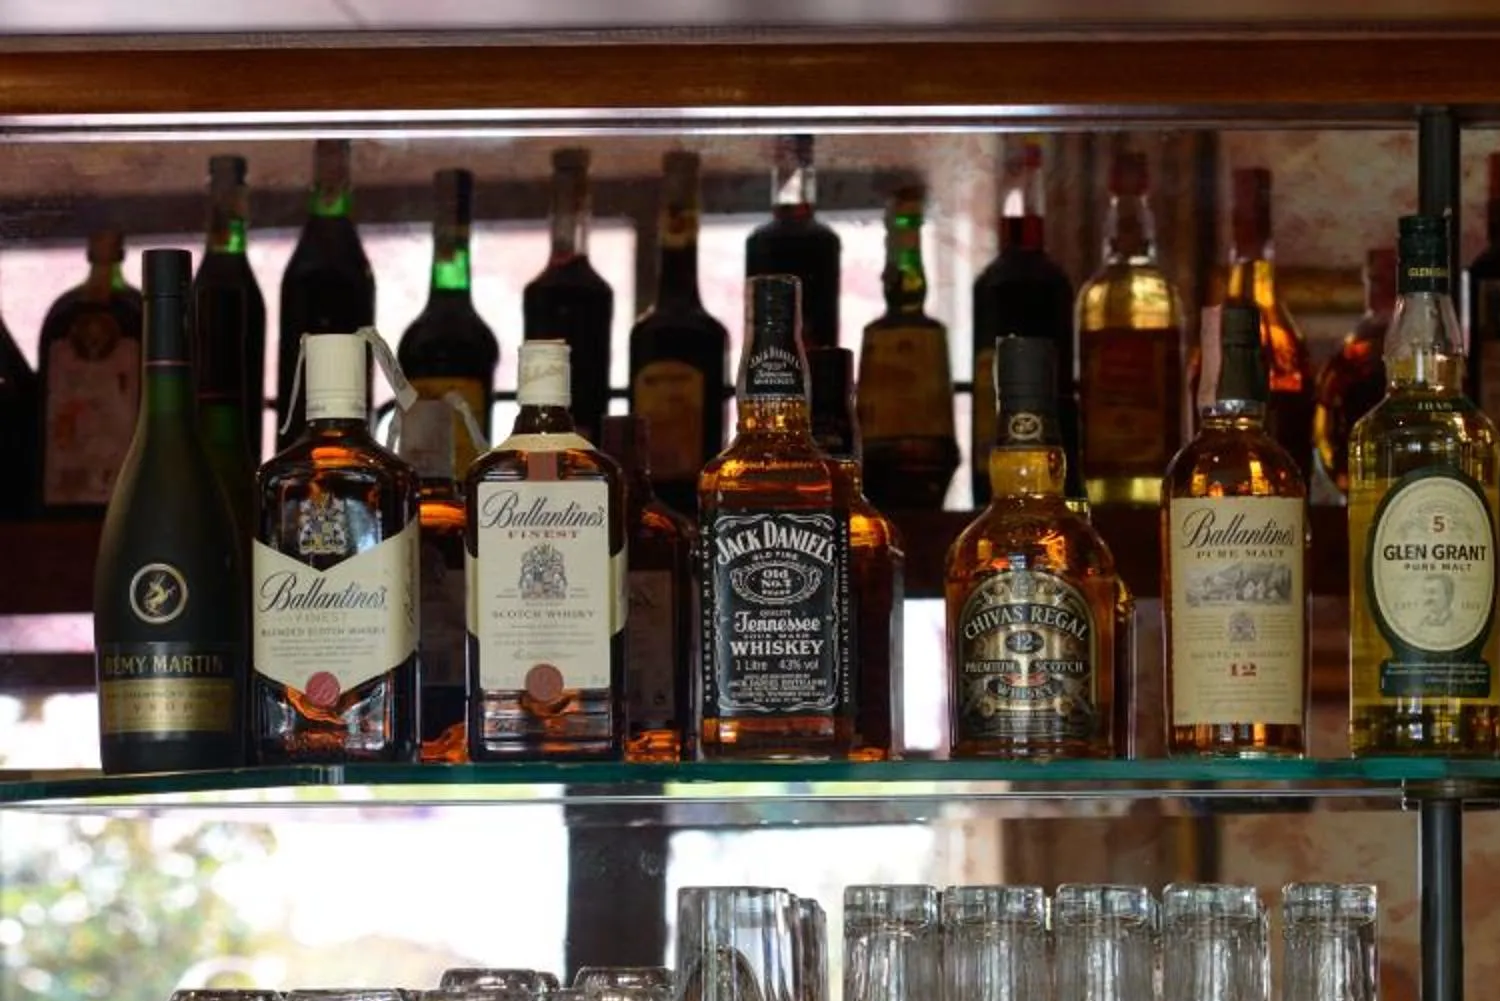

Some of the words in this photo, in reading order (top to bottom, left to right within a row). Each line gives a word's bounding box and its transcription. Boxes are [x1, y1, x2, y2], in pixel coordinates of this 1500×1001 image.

[480, 490, 606, 529] Ballantine's
[1181, 508, 1296, 549] Ballantine's
[1432, 516, 1446, 533] 5
[508, 530, 578, 539] FINEST
[715, 528, 761, 565] JACK
[763, 520, 837, 563] DANIEL'S
[1245, 549, 1285, 558] MALT
[1383, 543, 1427, 561] GLEN
[1432, 543, 1487, 561] GRANT
[763, 569, 789, 579] Old
[1404, 563, 1436, 571] PURE
[1442, 563, 1472, 571] MALT
[257, 570, 388, 612] Ballantine's
[492, 610, 541, 619] SCOTCH
[547, 609, 595, 618] WHISKY
[760, 609, 792, 617] QUALITY
[735, 611, 821, 632] Tennessee
[964, 606, 1024, 641] CHIVAS
[1031, 605, 1088, 641] REGAL
[730, 640, 824, 655] WHISKEY
[1013, 635, 1033, 651] 12
[153, 656, 223, 673] MARTIN
[803, 659, 820, 670] vol
[965, 660, 1016, 673] PREMIUM
[1035, 660, 1084, 673] SCOTCH
[1231, 662, 1257, 677] 12
